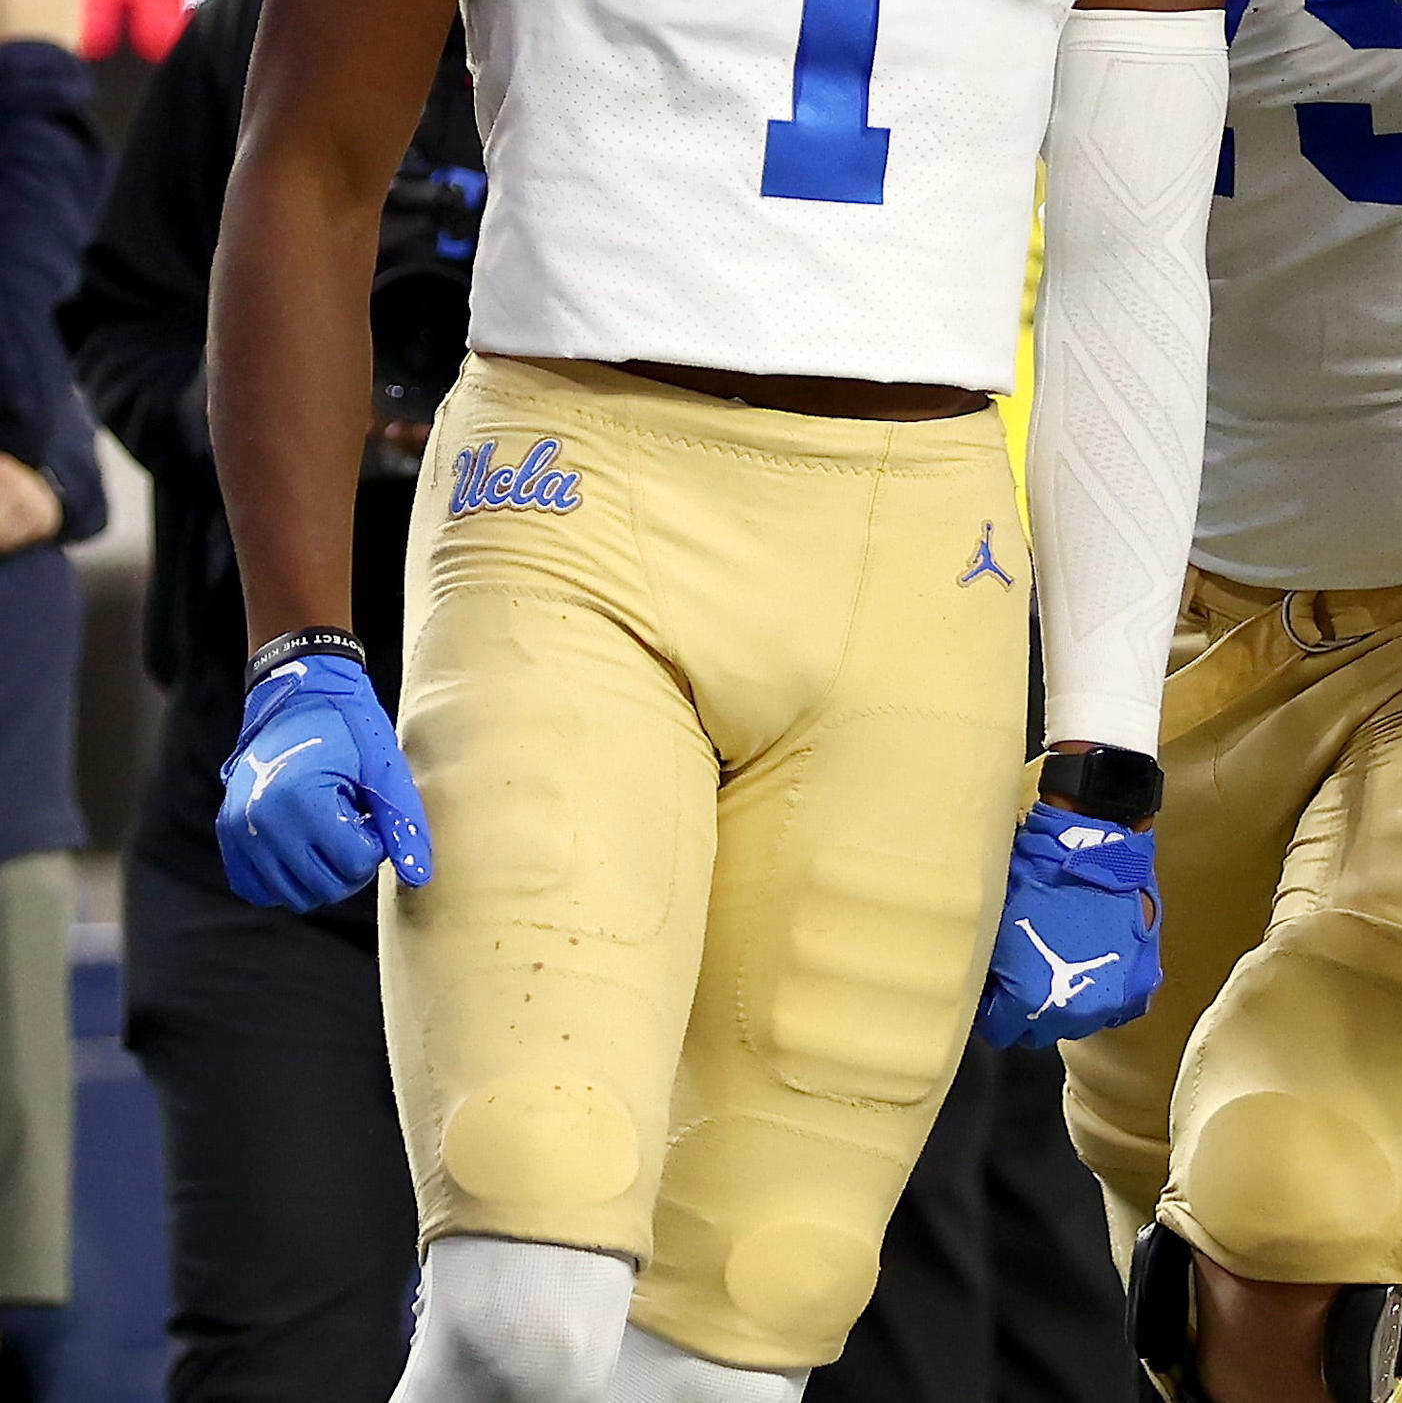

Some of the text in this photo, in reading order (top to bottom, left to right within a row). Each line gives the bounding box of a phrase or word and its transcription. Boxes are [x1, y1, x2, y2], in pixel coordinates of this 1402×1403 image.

[449, 437, 584, 517] Ucla
[282, 635, 309, 652] THE
[252, 647, 281, 672] KING
